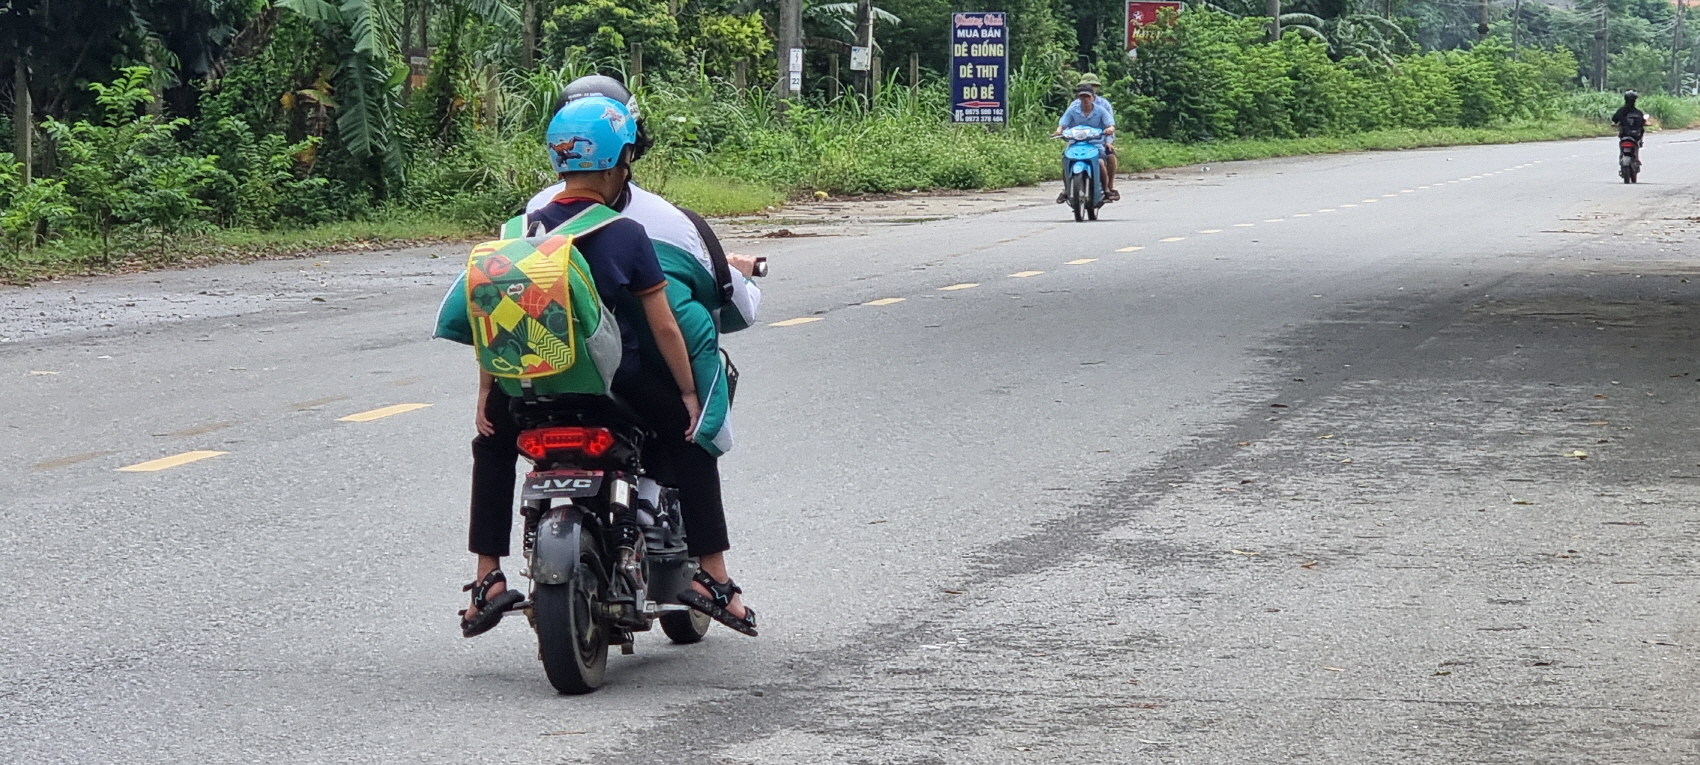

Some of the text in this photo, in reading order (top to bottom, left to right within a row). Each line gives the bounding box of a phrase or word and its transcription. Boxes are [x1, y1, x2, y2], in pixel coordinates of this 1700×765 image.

[957, 27, 1002, 38] MUA BÁN
[954, 39, 1004, 57] DÊ GIỐNG
[959, 62, 999, 81] DÊ THỊT
[980, 83, 995, 100] BÊ
[532, 479, 592, 489] JVC
